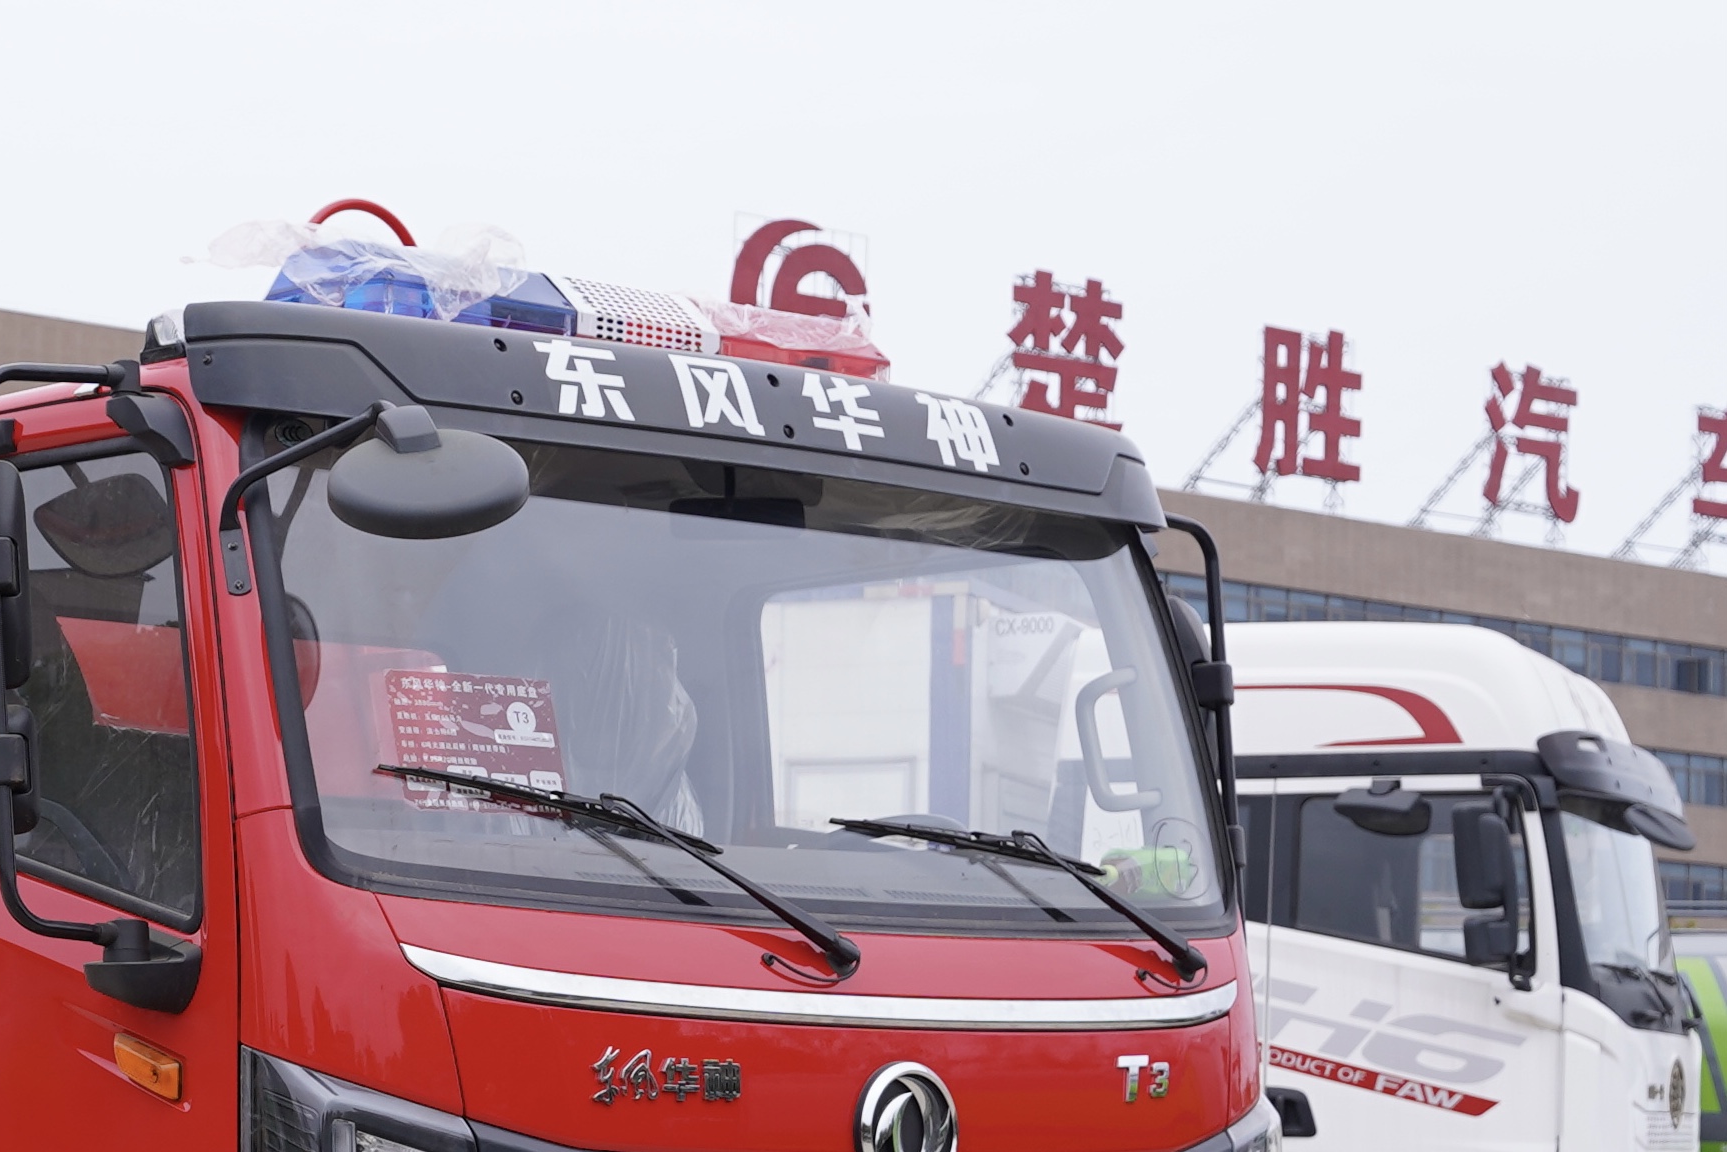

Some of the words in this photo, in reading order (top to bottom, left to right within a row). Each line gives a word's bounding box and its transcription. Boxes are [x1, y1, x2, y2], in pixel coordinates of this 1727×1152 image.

[532, 339, 1001, 473] 东风华神
[513, 710, 530, 725] T3
[1116, 1054, 1171, 1103] T3
[1336, 1065, 1368, 1085] OF
[1374, 1073, 1465, 1109] FAW
